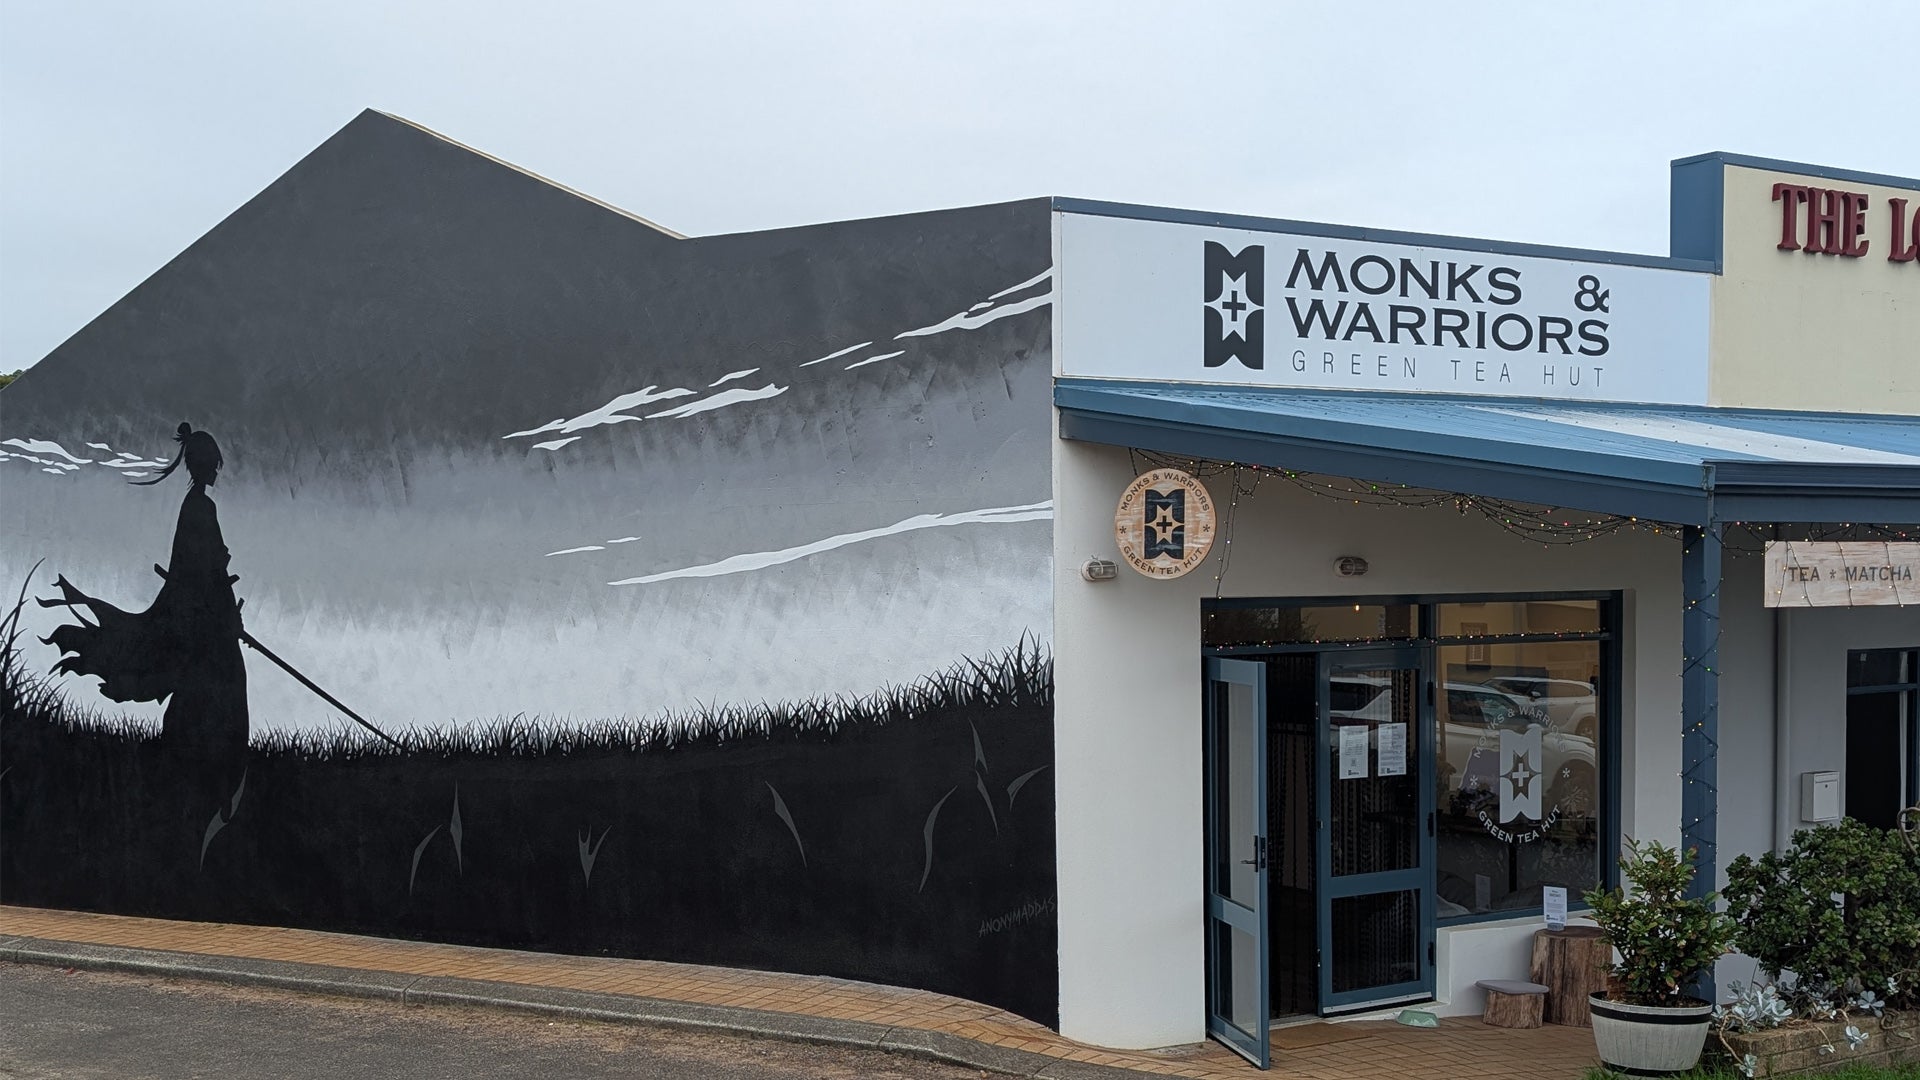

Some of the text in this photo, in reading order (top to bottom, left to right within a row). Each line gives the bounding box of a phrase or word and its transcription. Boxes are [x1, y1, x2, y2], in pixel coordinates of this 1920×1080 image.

[1772, 183, 1869, 258] THE
[1285, 249, 1609, 313] MONKS &
[1285, 297, 1610, 356] WARRIORS
[1292, 350, 1604, 388] GREEN TEA HUT
[1121, 472, 1210, 512] MONKS & WARRIORS
[1123, 546, 1203, 575] GREEN TEA HUT
[1788, 566, 1912, 582] TEA MATCHA
[1507, 708, 1516, 718] &
[1479, 804, 1560, 843] GREEN TEA HUT
